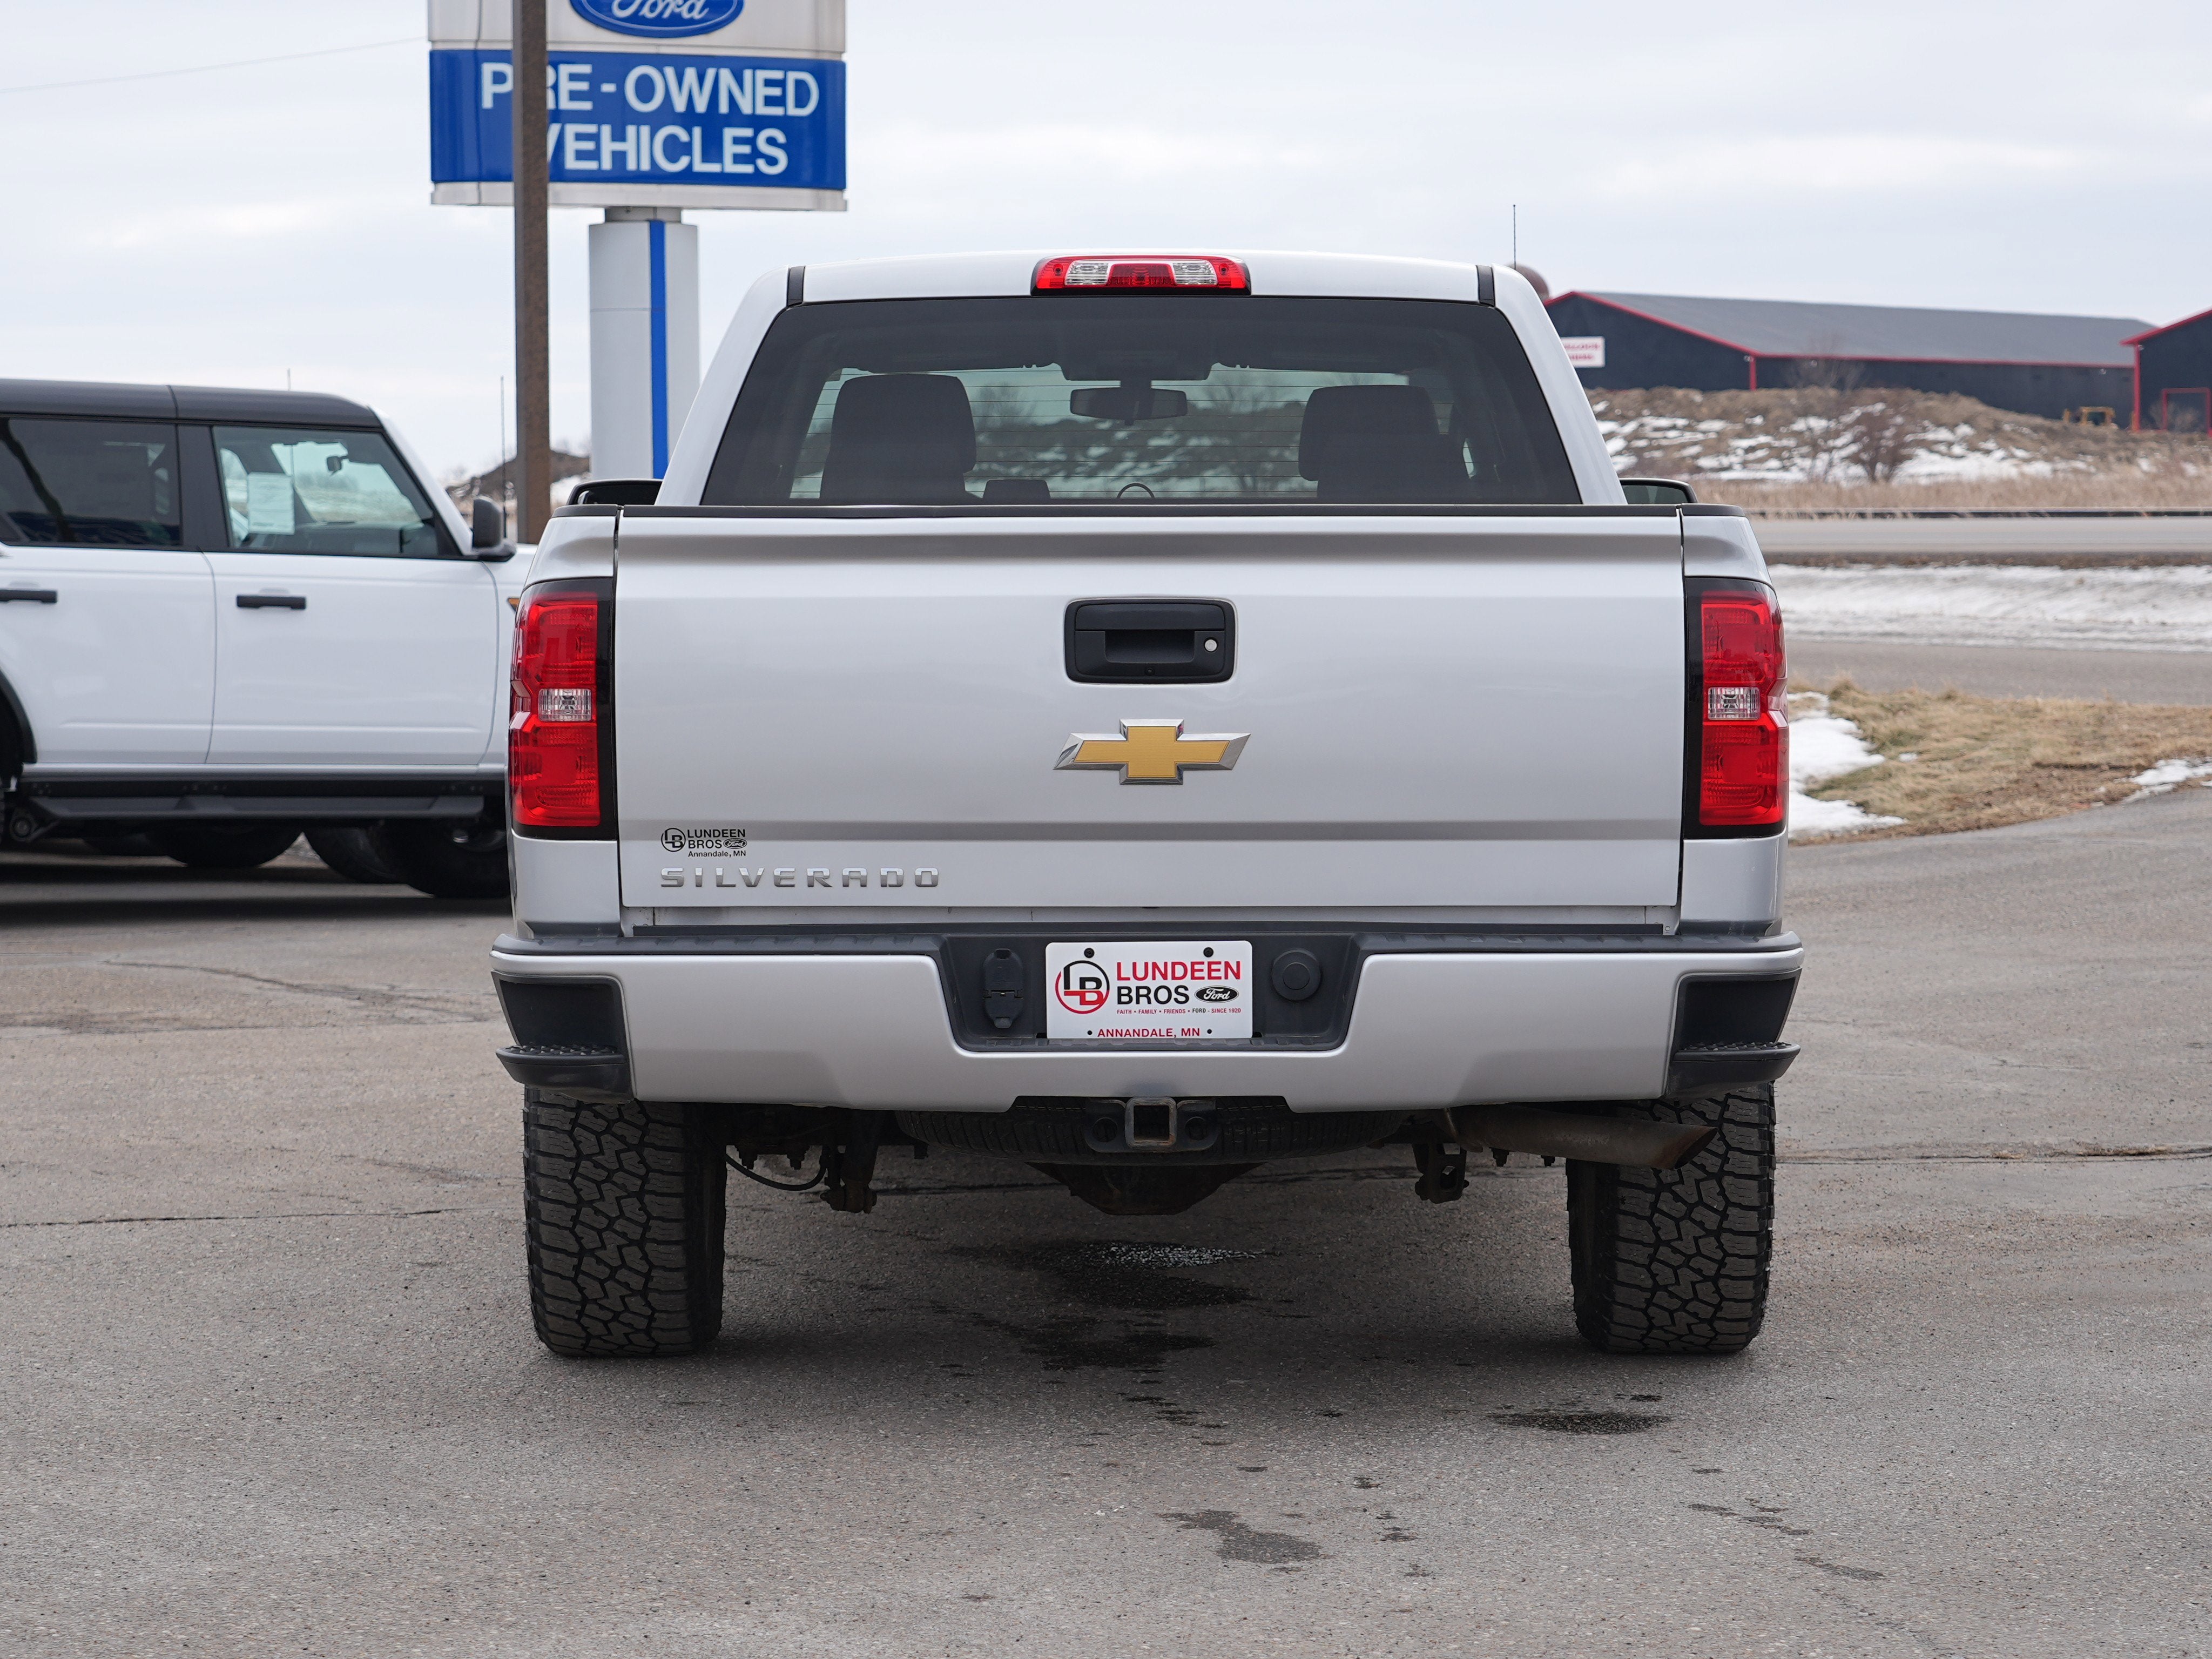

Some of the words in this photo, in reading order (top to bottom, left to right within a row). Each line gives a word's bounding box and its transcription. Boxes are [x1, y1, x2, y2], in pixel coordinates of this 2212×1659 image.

[481, 62, 819, 117] PE-OWNED
[687, 829, 746, 838] LUNDEEN
[688, 839, 723, 849] BROS
[660, 867, 939, 887] SILVERADO
[1117, 961, 1241, 981] LUNDEEN
[1117, 985, 1190, 1005] BROS
[1097, 1028, 1177, 1038] ANNANDALE,
[1181, 1028, 1200, 1036] MN
